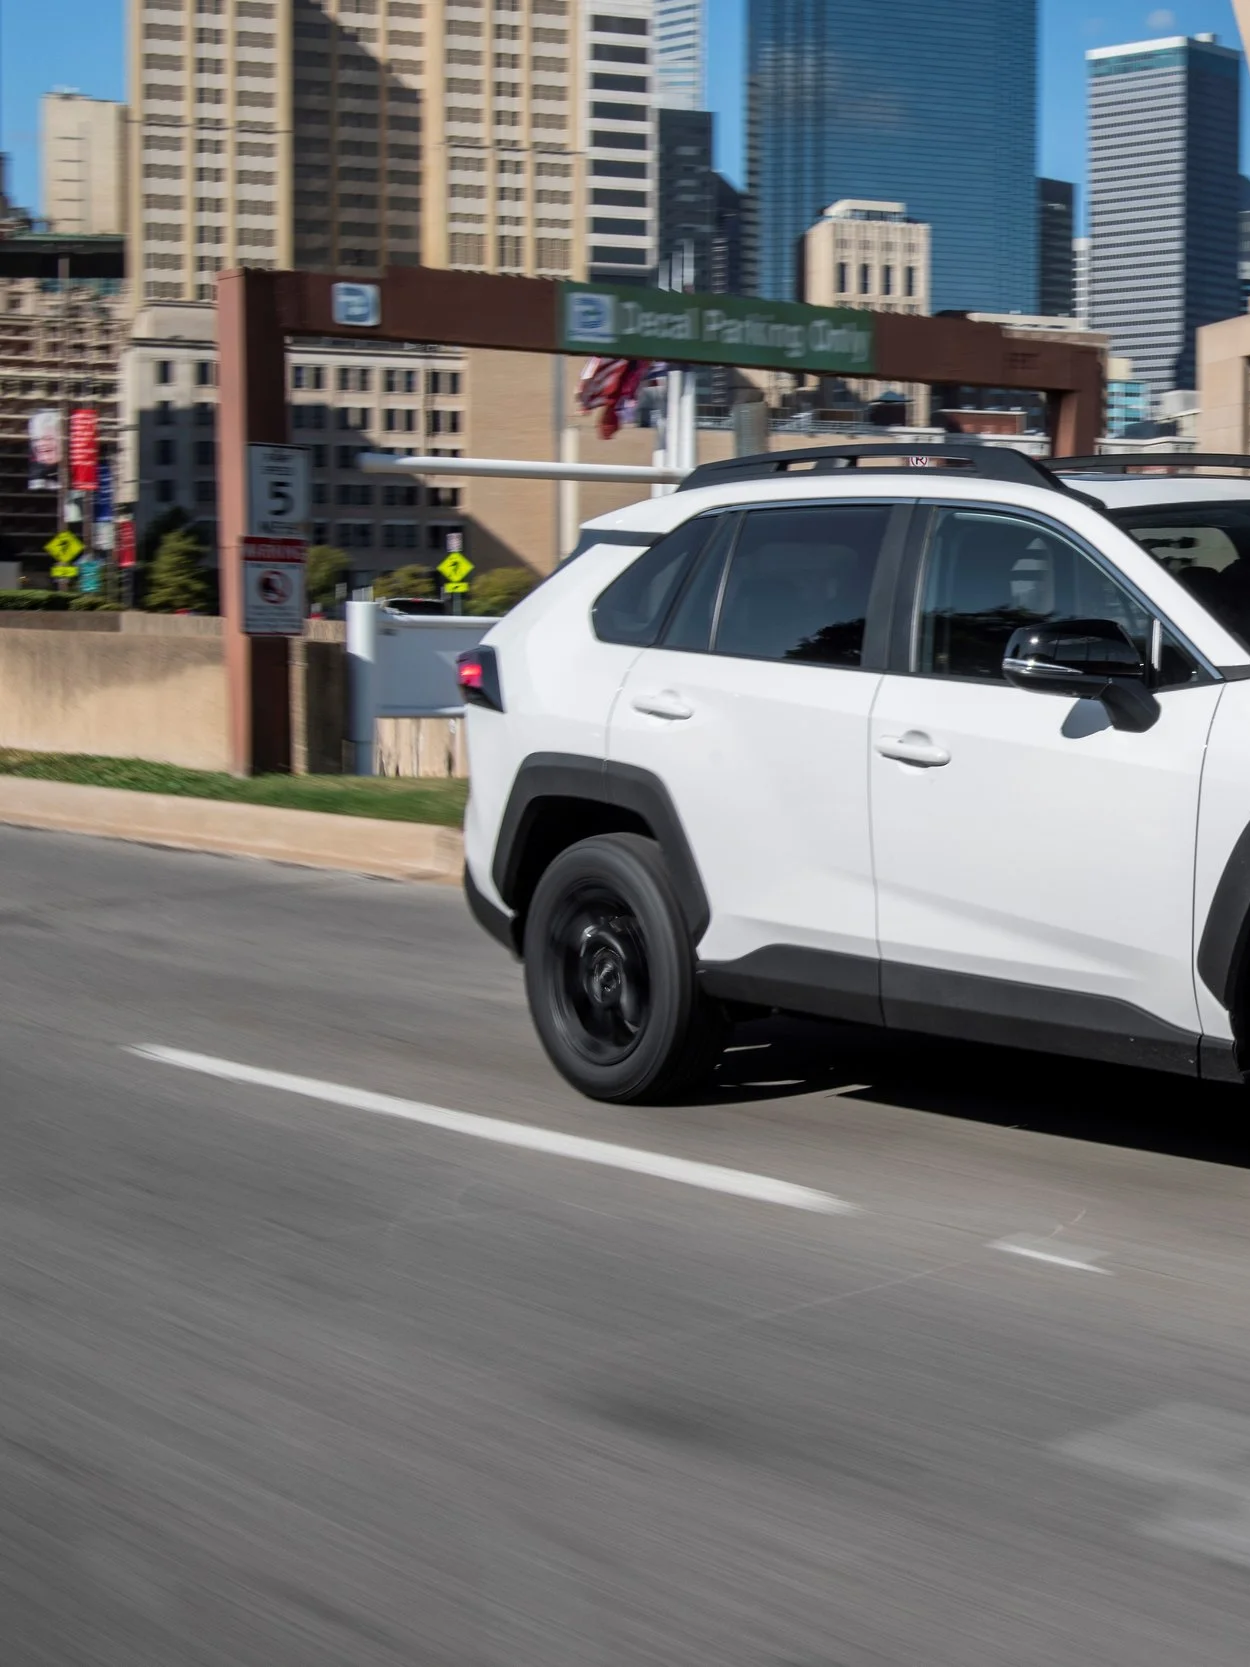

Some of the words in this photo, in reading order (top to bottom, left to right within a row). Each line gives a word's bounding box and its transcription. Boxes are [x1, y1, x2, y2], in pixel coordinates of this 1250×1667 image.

[703, 309, 805, 358] Parking
[808, 318, 871, 363] Only
[267, 481, 295, 516] 5
